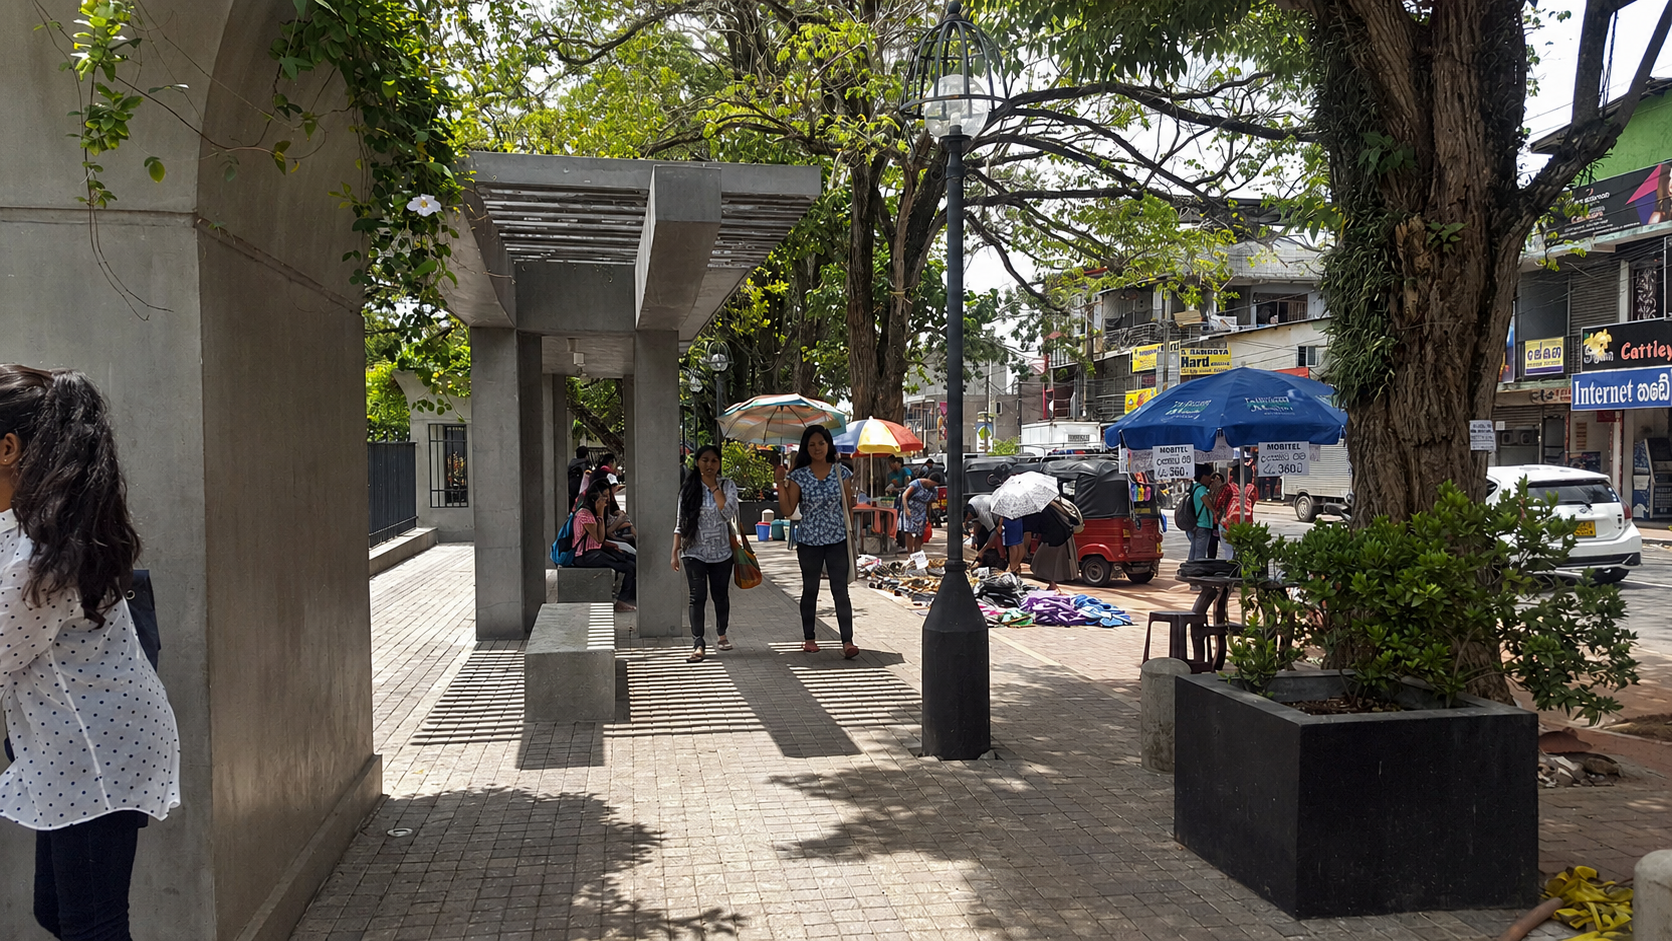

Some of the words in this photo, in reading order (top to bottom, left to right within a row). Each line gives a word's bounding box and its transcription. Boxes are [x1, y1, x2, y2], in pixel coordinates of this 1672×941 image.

[1181, 356, 1210, 368] Hard
[1574, 379, 1634, 406] Internet
[1159, 446, 1188, 454] MOBITEL
